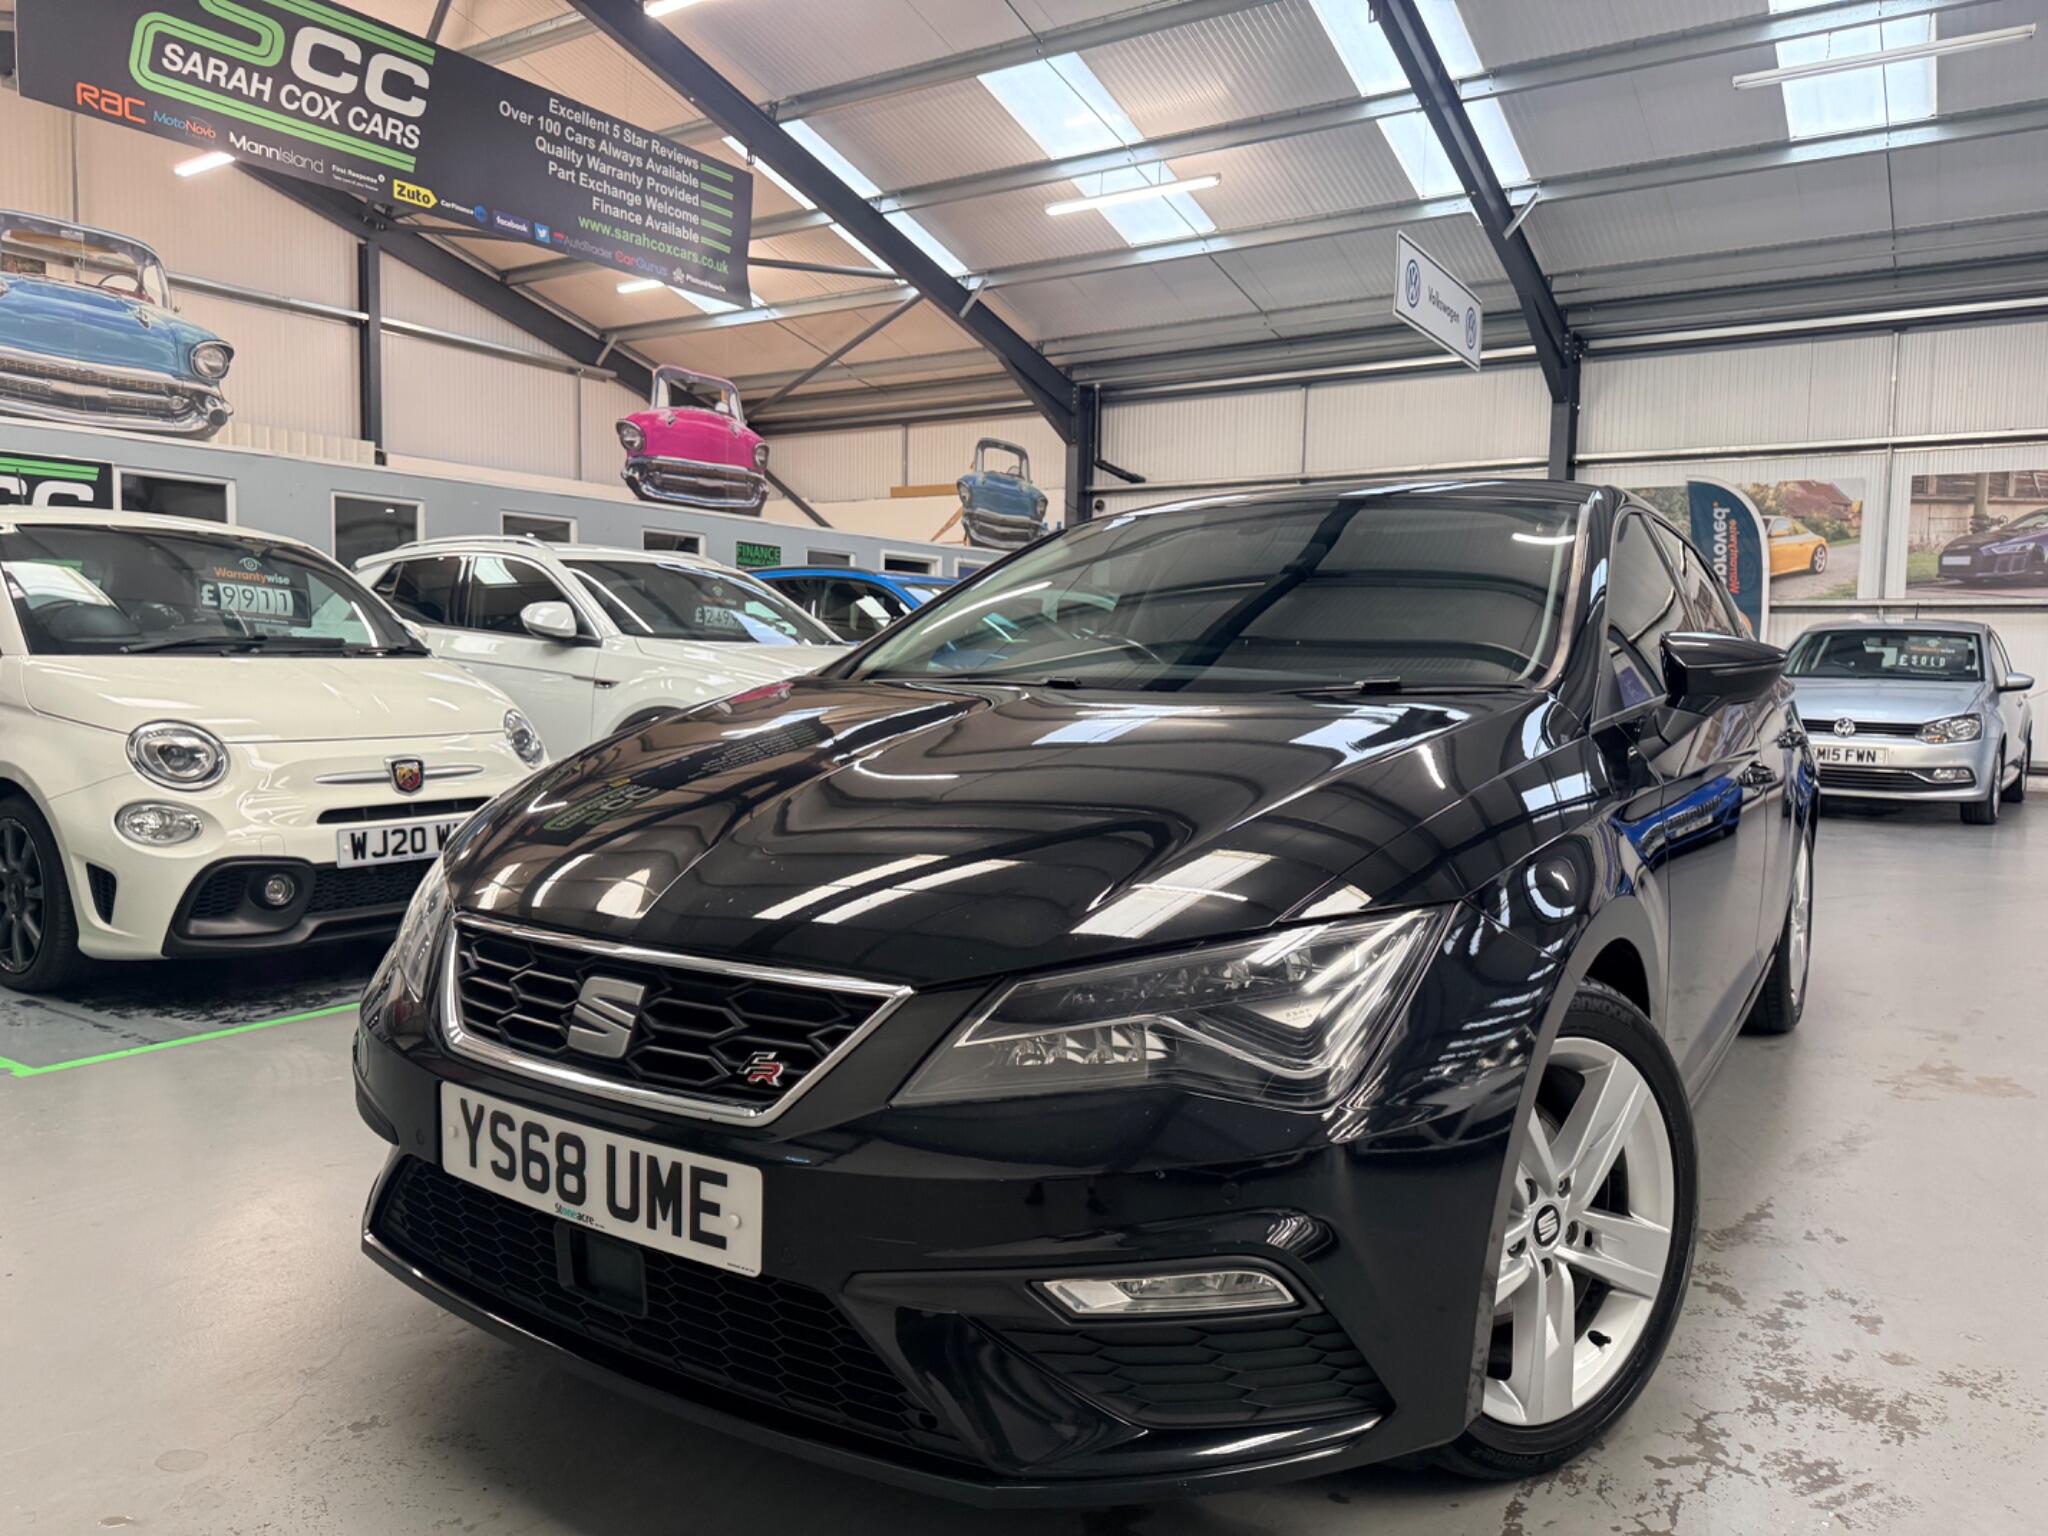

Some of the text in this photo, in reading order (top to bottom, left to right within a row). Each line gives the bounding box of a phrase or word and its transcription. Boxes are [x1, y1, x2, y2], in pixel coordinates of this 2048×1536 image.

[161, 43, 421, 150] SARAH COX CARS
[153, 110, 217, 139] MotoNovo
[549, 98, 699, 170] Excellent 5 Star Reviews
[499, 100, 699, 188] Over 100 Cars Always Available
[535, 135, 699, 207] Quality Warranty Provided
[397, 183, 431, 205] Zuto
[549, 161, 699, 225] Part Exchange Welcome
[496, 215, 529, 233] facebook
[592, 196, 699, 244] Finance Available
[578, 215, 730, 274] www.sarahcoxcars.co.uk
[614, 251, 669, 277] CarGurus
[1428, 285, 1460, 323] Volkswagen
[736, 543, 781, 561] FINANCE
[214, 566, 290, 586] Warrantywise
[1845, 748, 1876, 763] FWN
[350, 823, 458, 860] WJ20 W
[460, 1098, 728, 1250] YS68 UME
